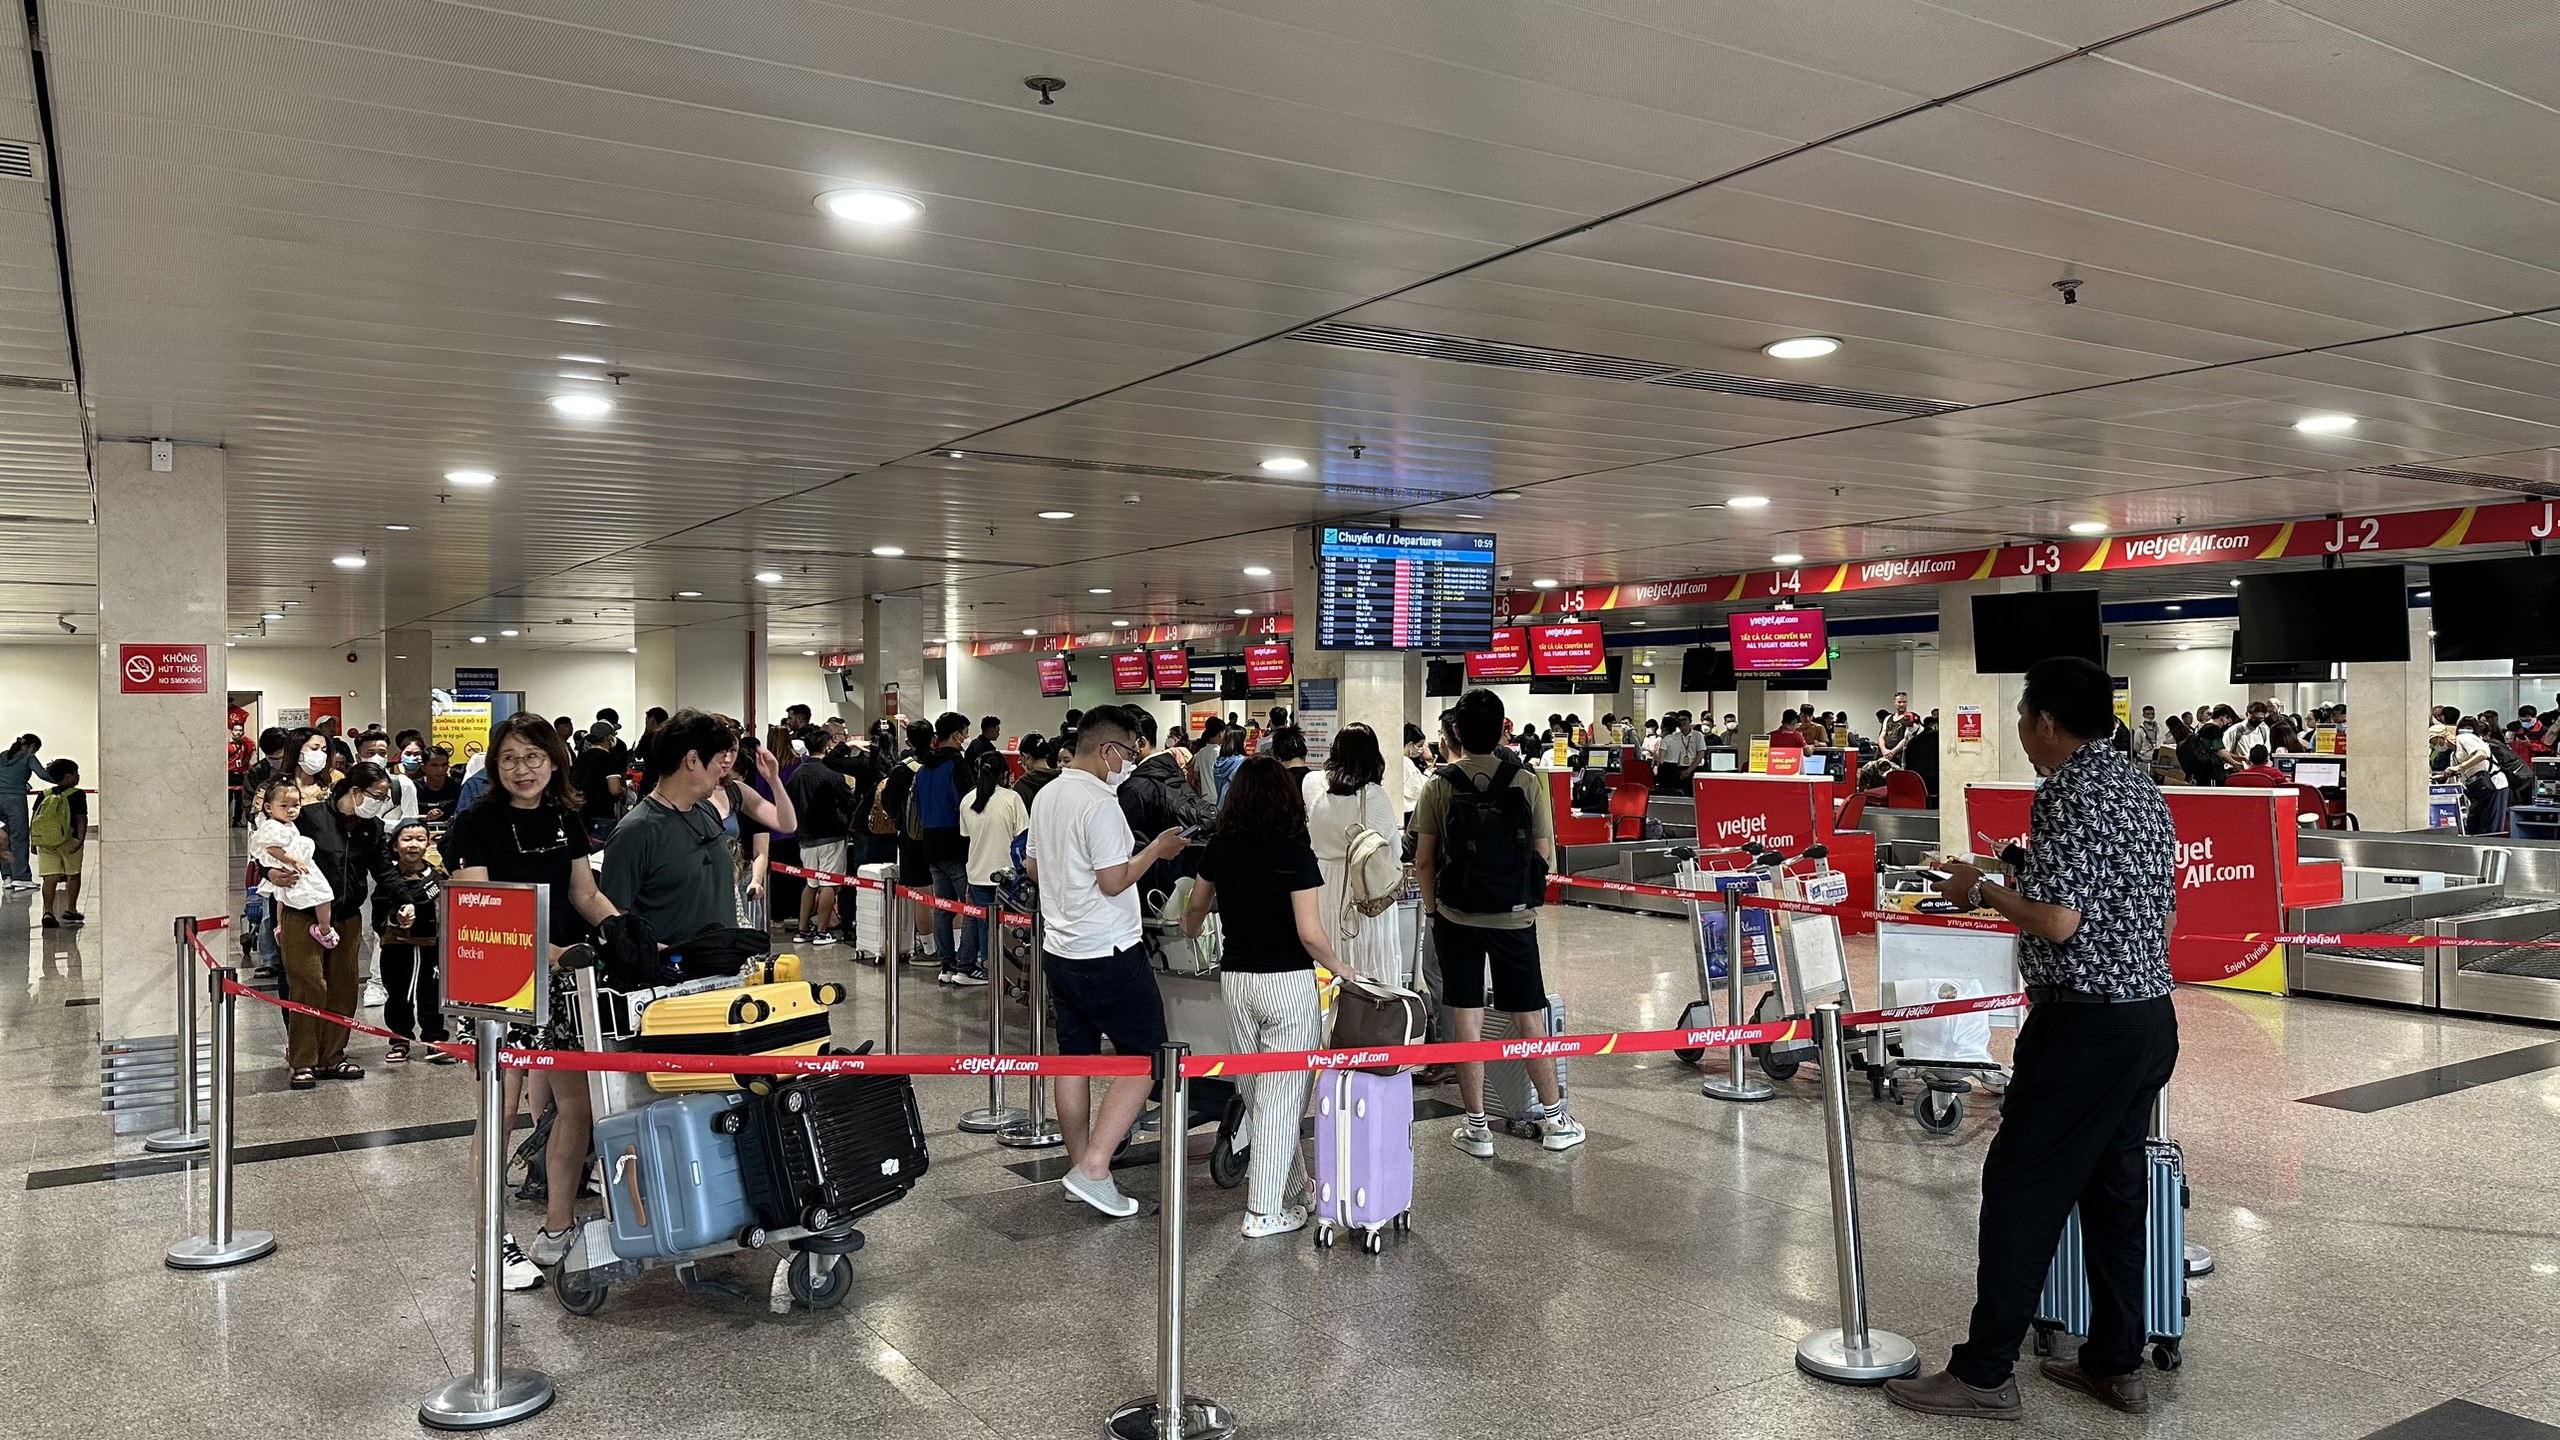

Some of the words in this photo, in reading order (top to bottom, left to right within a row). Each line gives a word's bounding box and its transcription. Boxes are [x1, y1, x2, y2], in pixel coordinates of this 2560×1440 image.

[1338, 532, 1374, 545] Chuyến
[1375, 534, 1385, 544] đi
[1393, 534, 1442, 547] Departures
[2325, 518, 2379, 552] J-2
[1474, 539, 1493, 548] 10:59
[2020, 545, 2060, 574] J-3
[1769, 569, 1801, 595] J-4
[1561, 591, 1584, 612] J-5
[1260, 616, 1275, 634] J-8
[1122, 630, 1138, 644] J-10
[1164, 627, 1178, 641] J-9
[1044, 638, 1057, 651] J-11
[162, 652, 198, 663] KHÔNG
[158, 664, 174, 673] HÚT
[176, 664, 202, 673] THUỐC
[2174, 837, 2213, 869] tjet
[2182, 863, 2255, 890] Air.com
[458, 925, 468, 941] LỐI
[470, 927, 485, 943] VÀO
[486, 928, 501, 944] LÀM
[503, 928, 517, 946] THỦ
[519, 933, 533, 950] TỤC
[458, 946, 484, 960] Check-in
[2224, 960, 2247, 974] Enjoy
